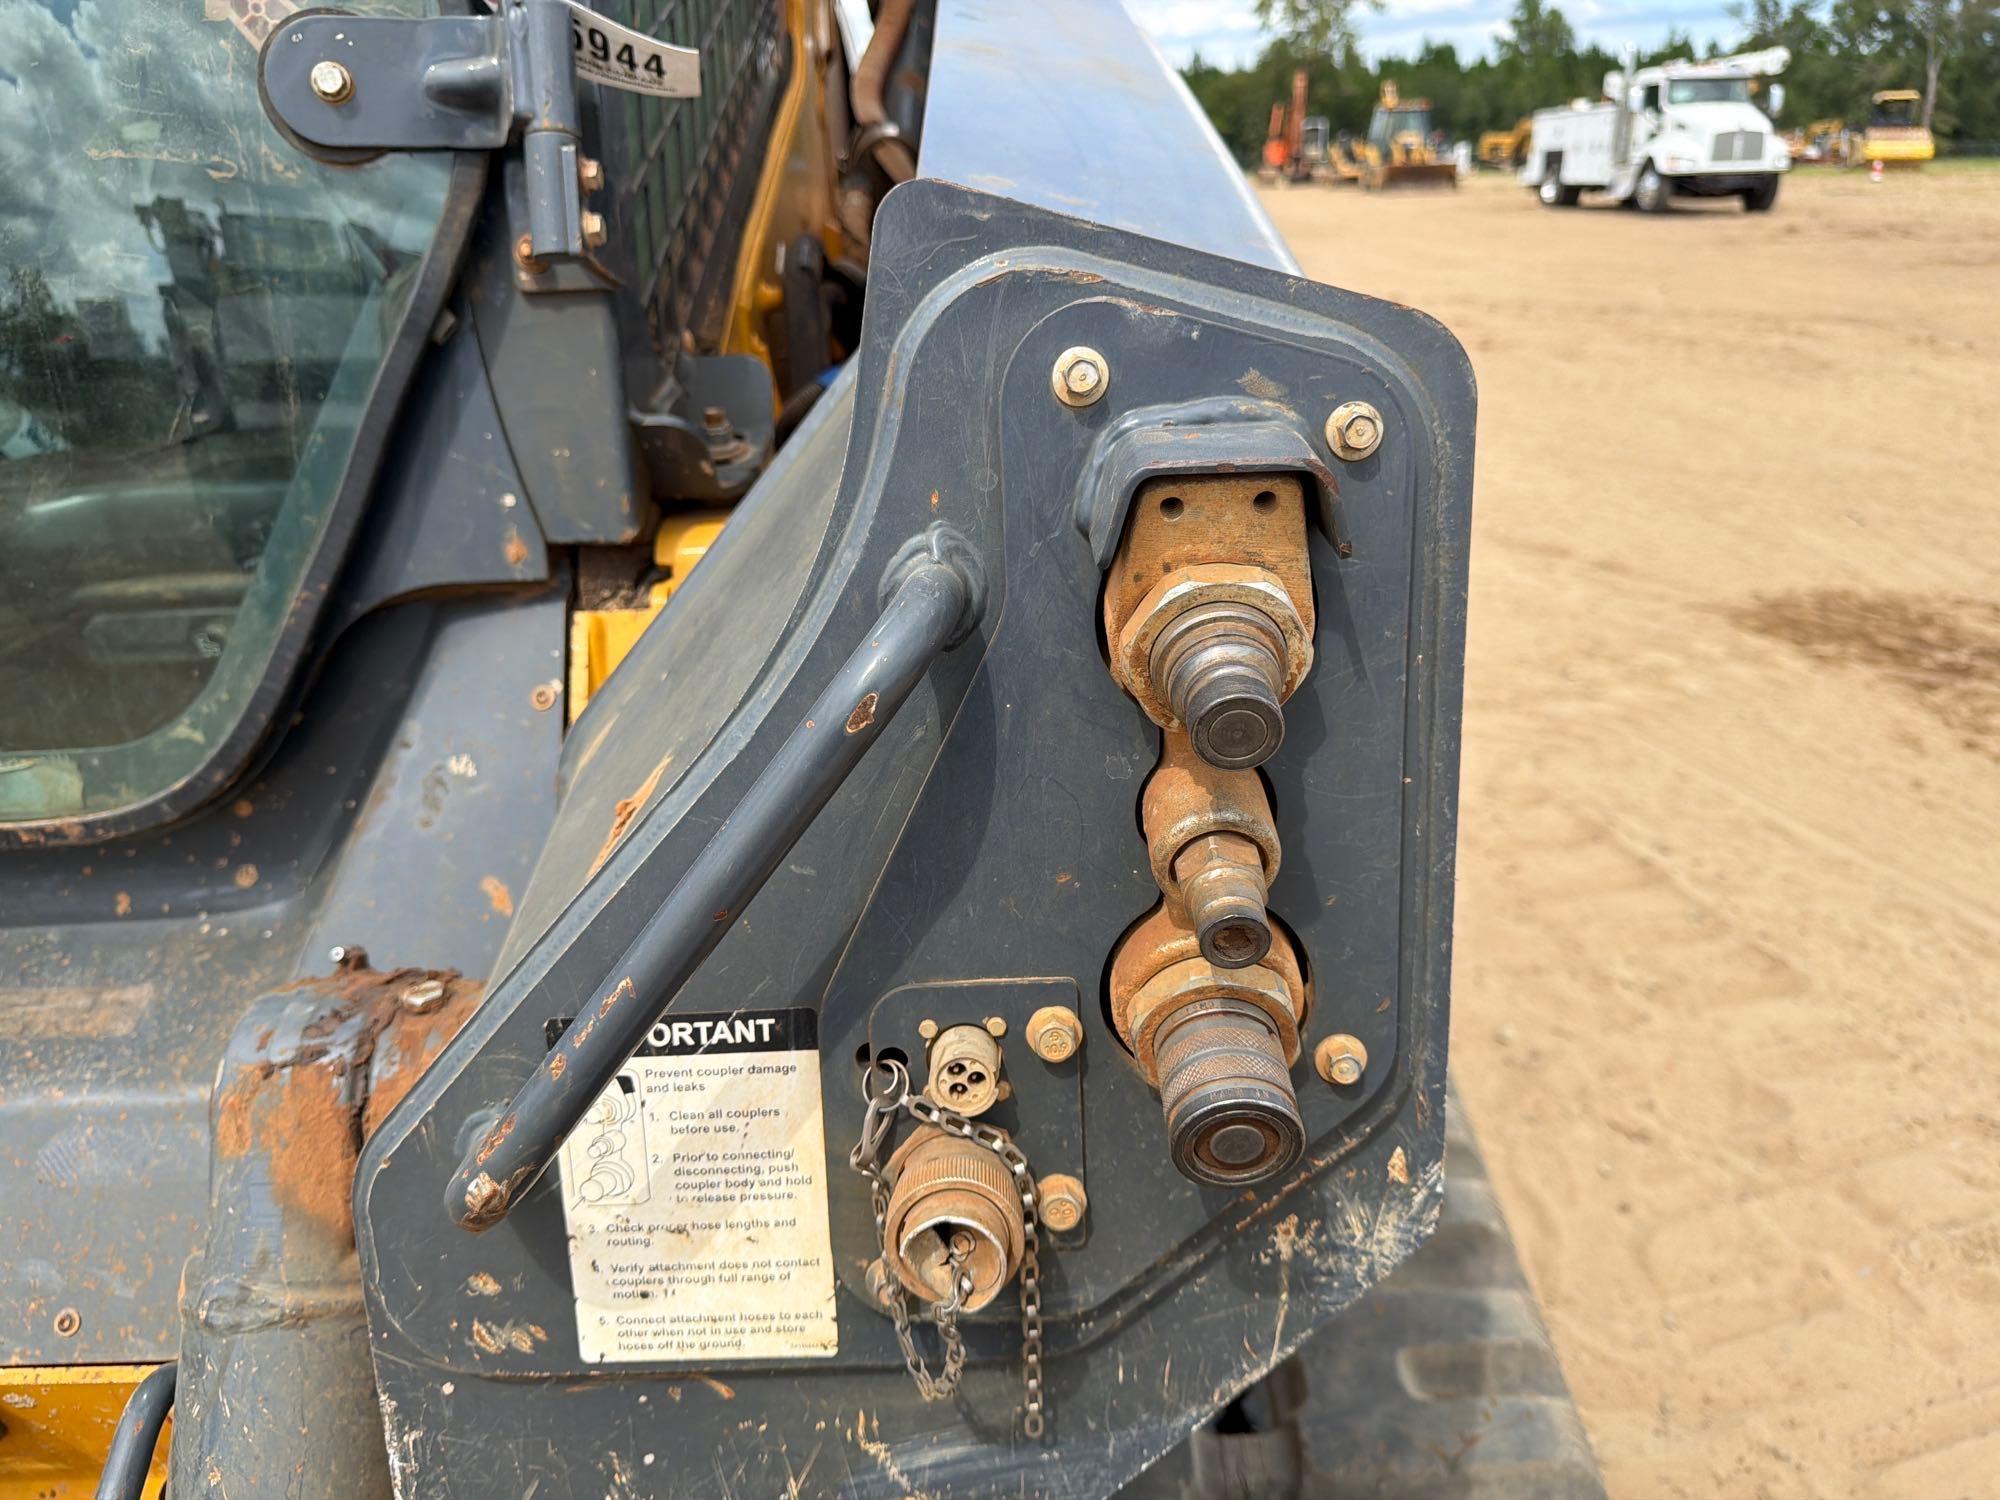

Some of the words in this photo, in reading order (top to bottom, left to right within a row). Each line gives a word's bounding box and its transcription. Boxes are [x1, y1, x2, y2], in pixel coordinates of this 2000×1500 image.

[648, 1019, 775, 1047] ORTANT
[645, 1068, 693, 1078] Prevent
[697, 1065, 744, 1077] coupler
[748, 1064, 797, 1075] damage
[646, 1083, 669, 1093] and
[673, 1082, 706, 1092] leaks
[669, 1110, 705, 1121] Clean
[708, 1109, 722, 1119] all
[726, 1107, 780, 1119] couplers
[670, 1124, 710, 1135] before
[673, 1152, 703, 1163] Prior
[706, 1152, 719, 1162] to
[674, 1164, 765, 1177] disconnecting,
[769, 1163, 799, 1175] push
[675, 1180, 722, 1193] coupler
[725, 1178, 755, 1190] body
[759, 1176, 782, 1187] and
[786, 1175, 813, 1186] hold
[692, 1193, 736, 1203] release
[740, 1192, 798, 1203] pressure.
[606, 1222, 644, 1233] Check
[692, 1220, 722, 1230] hose
[725, 1218, 770, 1231] lengths
[774, 1216, 797, 1227] and
[607, 1236, 654, 1248] routing.
[611, 1263, 645, 1274] Verify
[649, 1261, 715, 1272] attachment
[720, 1260, 749, 1270] does
[752, 1259, 772, 1269] not
[776, 1258, 821, 1268] contact
[612, 1276, 664, 1287] couplers
[667, 1274, 715, 1286] through
[719, 1272, 738, 1282] full
[742, 1274, 776, 1284] range
[779, 1271, 791, 1281] of
[613, 1290, 658, 1299] motin.
[616, 1315, 666, 1325] Connect
[670, 1313, 736, 1323] attachment
[740, 1311, 776, 1322] hoses
[780, 1311, 791, 1321] to
[795, 1310, 823, 1320] each
[618, 1329, 648, 1338] other
[653, 1328, 684, 1337] when
[688, 1327, 706, 1336] not
[711, 1326, 721, 1335] in
[725, 1327, 747, 1335] use
[750, 1325, 772, 1335] and
[776, 1324, 806, 1333] store
[618, 1341, 654, 1350] hoses
[658, 1340, 673, 1349] off
[677, 1340, 695, 1349] the
